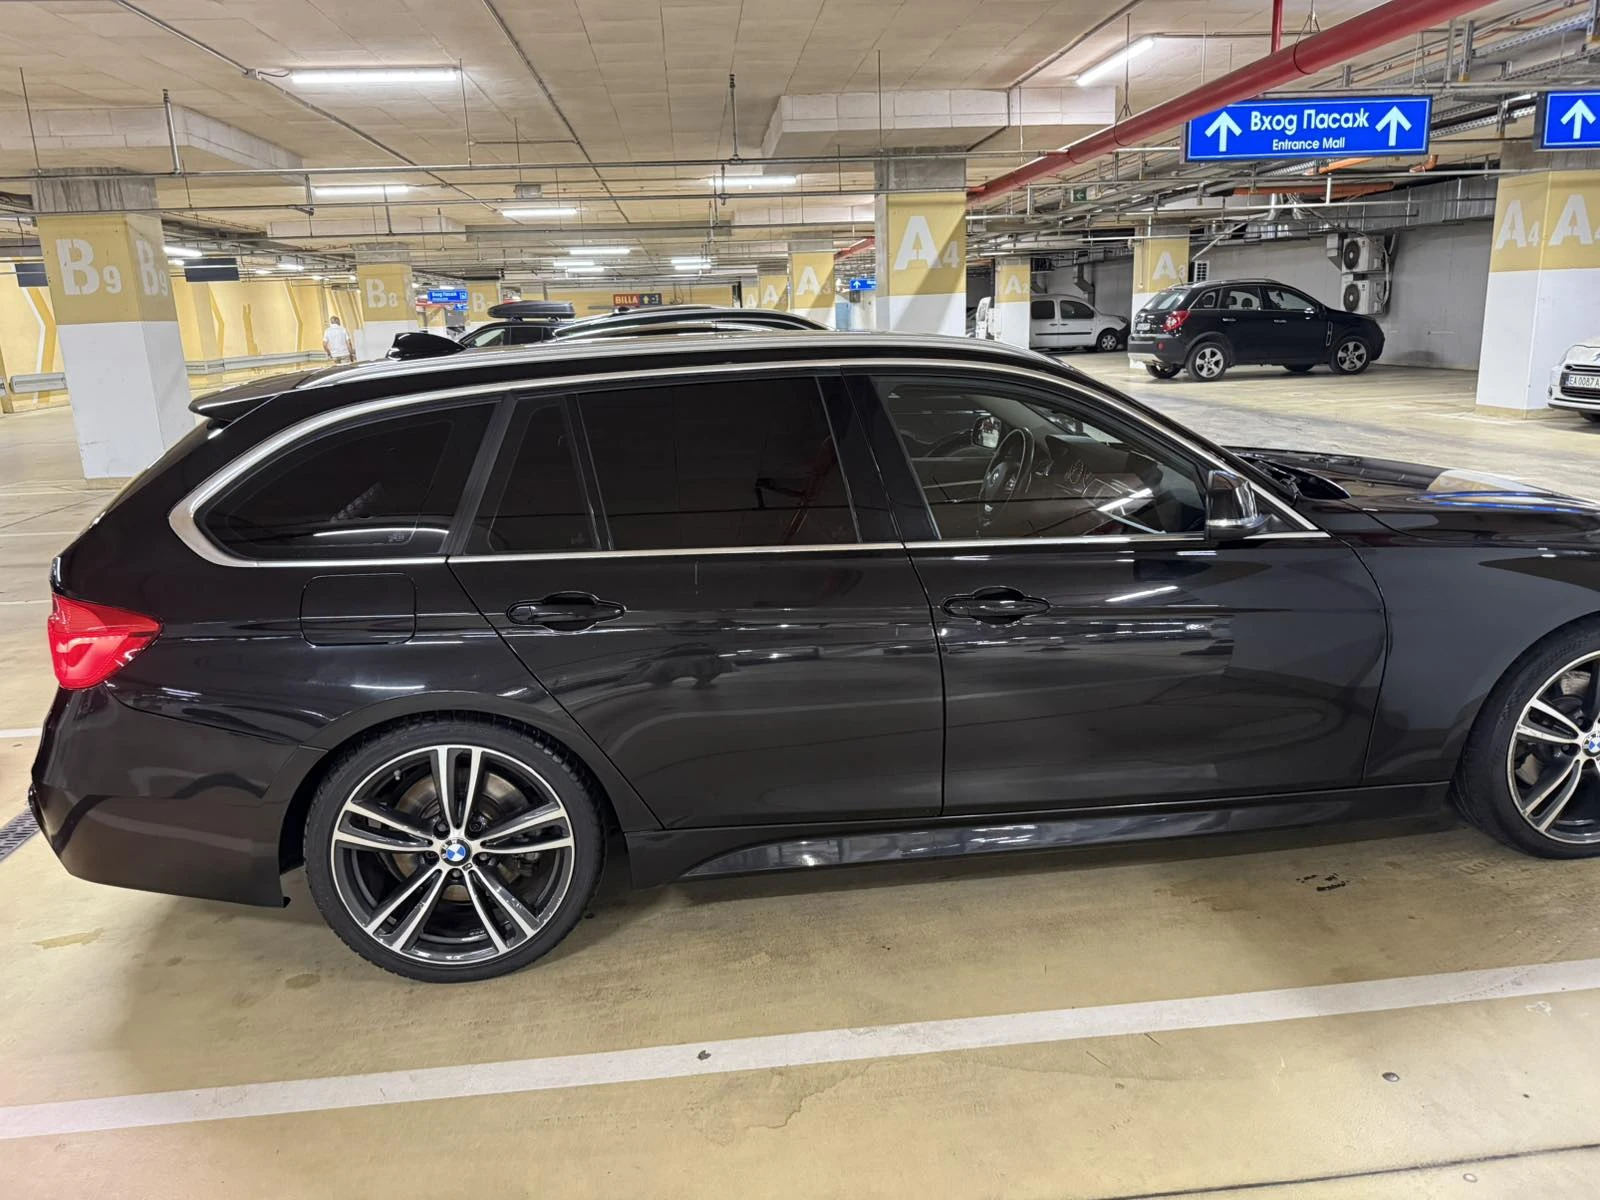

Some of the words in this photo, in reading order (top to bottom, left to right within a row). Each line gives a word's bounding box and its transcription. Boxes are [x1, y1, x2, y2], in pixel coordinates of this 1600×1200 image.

[1250, 111, 1298, 135] Вход
[1303, 108, 1370, 130] Пасаж
[1272, 138, 1320, 151] Entrance
[1322, 137, 1346, 149] Mall
[893, 215, 960, 271] A4
[1495, 200, 1540, 250] A4
[56, 239, 122, 296] B9
[136, 240, 169, 297] B9
[615, 295, 638, 305] BILLA
